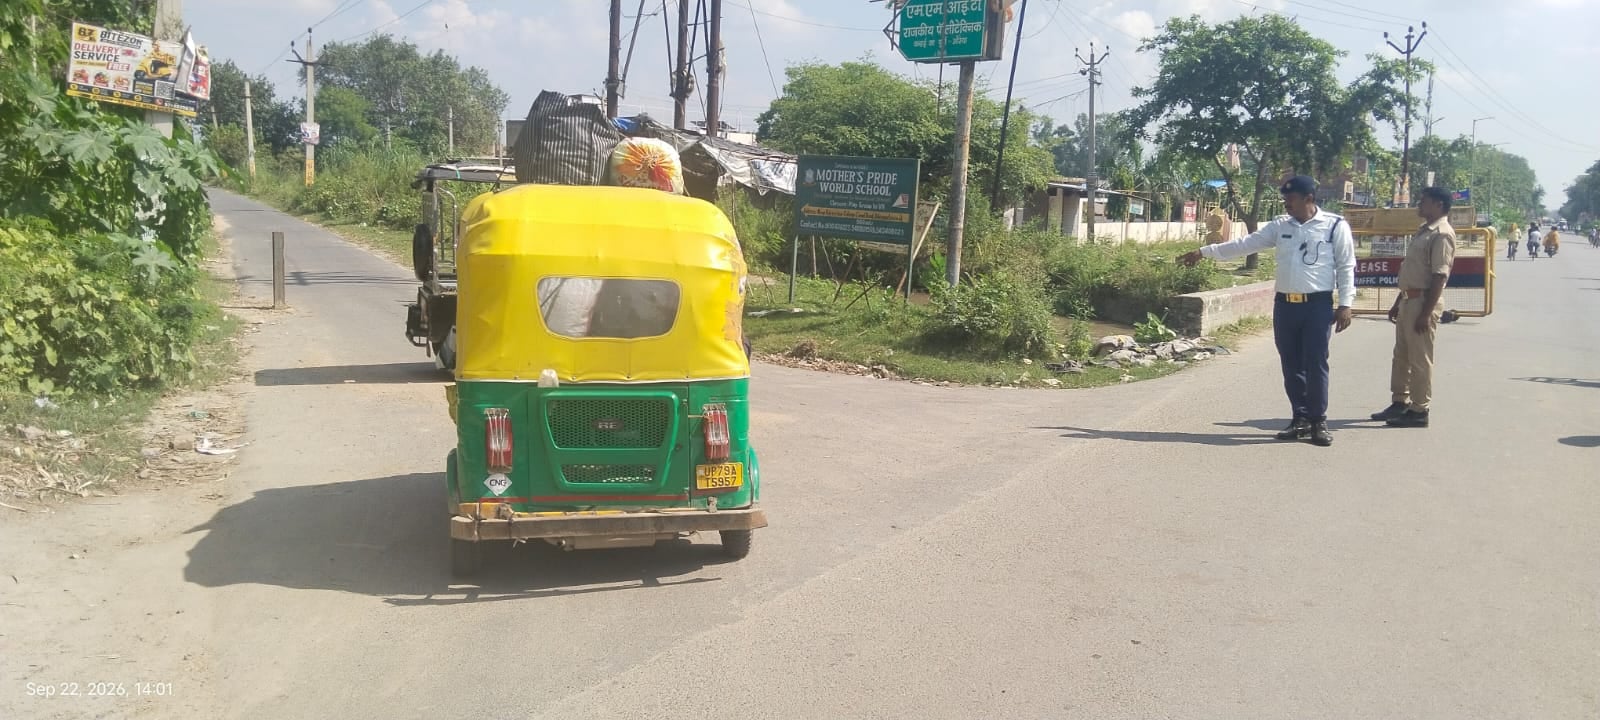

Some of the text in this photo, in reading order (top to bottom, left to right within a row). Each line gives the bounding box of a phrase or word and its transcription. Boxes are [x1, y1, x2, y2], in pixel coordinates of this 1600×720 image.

[903, 22, 934, 38] राजकीय
[74, 42, 119, 55] DELIVERY
[73, 50, 120, 63] SERVICE
[108, 63, 130, 71] FREE
[816, 169, 898, 185] MOTHER'S PRIDE
[819, 182, 892, 197] WORLD SCHOOL
[598, 421, 617, 429] RE
[704, 465, 737, 477] UP79A
[489, 478, 507, 487] CNG
[705, 476, 737, 488] T5957
